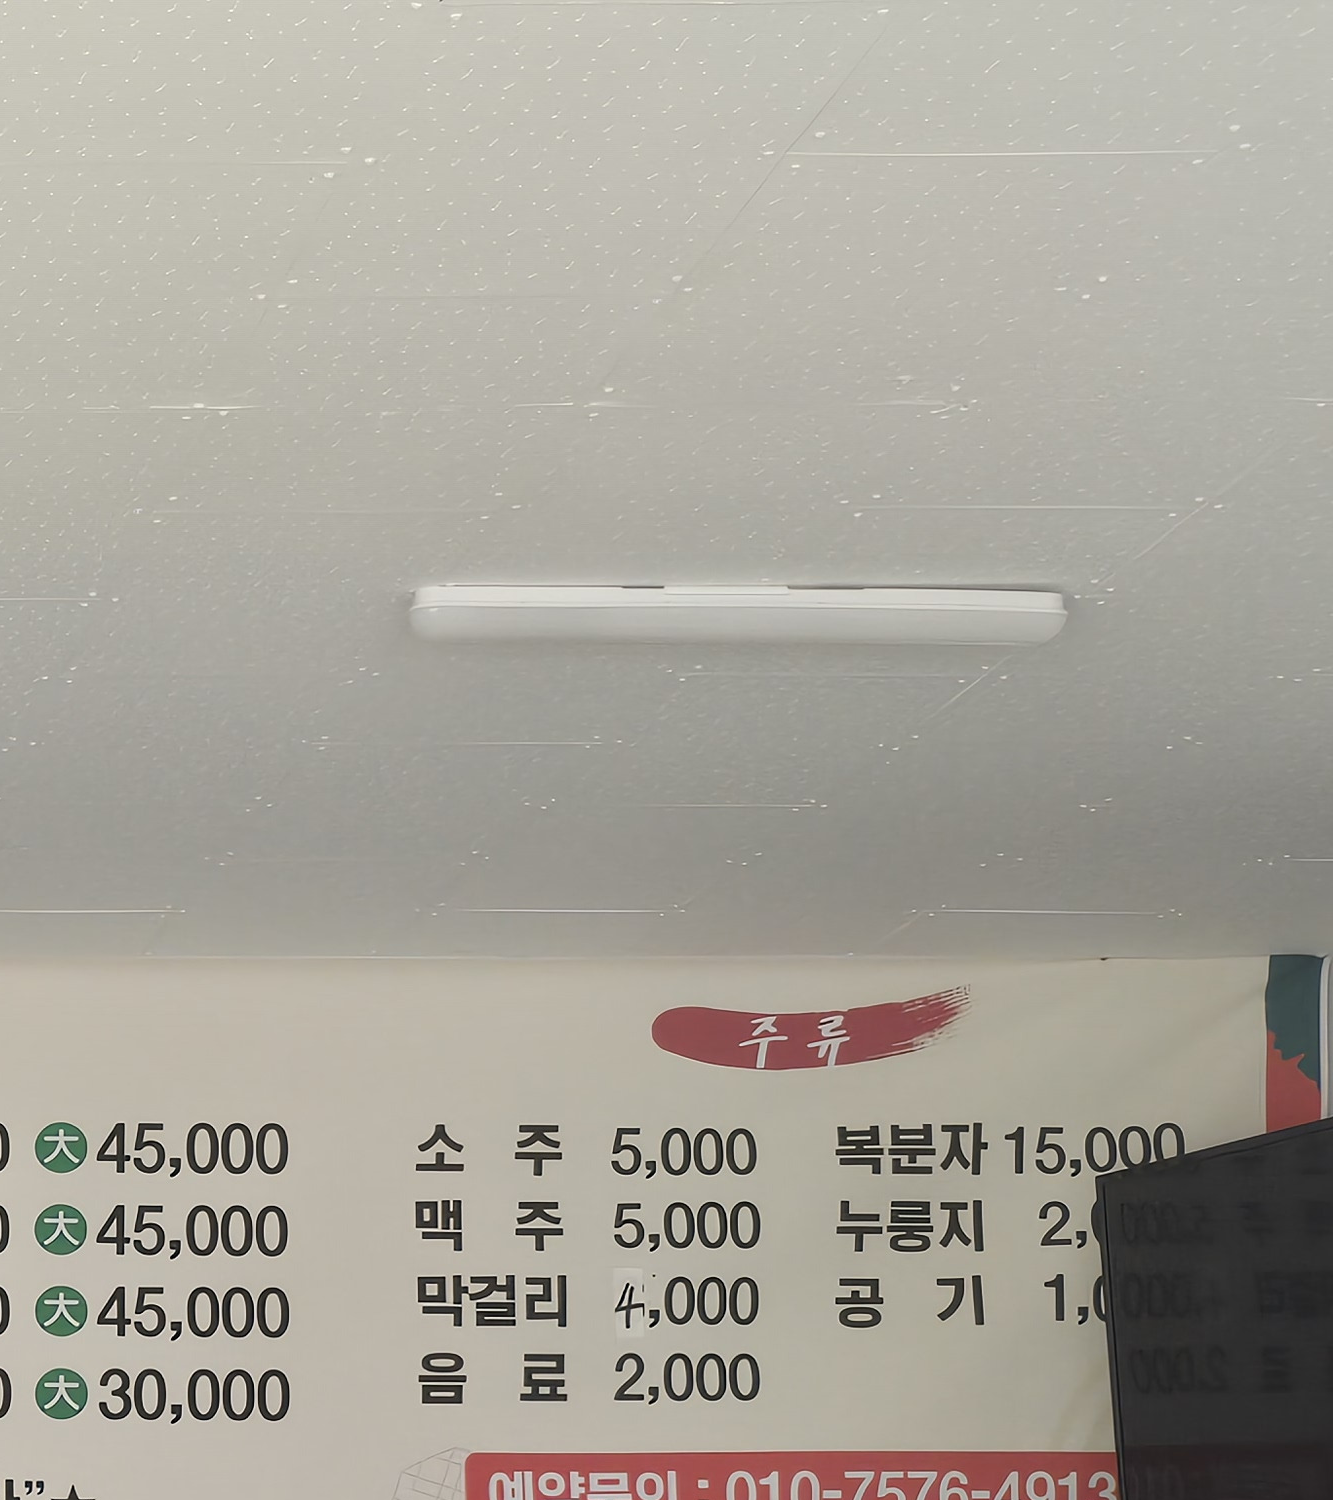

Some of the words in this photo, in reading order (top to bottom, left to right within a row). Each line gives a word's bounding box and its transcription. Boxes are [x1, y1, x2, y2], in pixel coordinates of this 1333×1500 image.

[96, 1122, 289, 1178] 45,000
[610, 1127, 758, 1180] 5,000
[835, 1122, 989, 1176] 복분자
[1004, 1122, 1185, 1178] 15,000
[95, 1204, 289, 1260] 45,000
[613, 1200, 761, 1253] 5,000
[835, 1199, 985, 1253] 누룽지
[96, 1286, 290, 1342] 45,000
[417, 1274, 567, 1328] 막걸리
[614, 1276, 760, 1330] 4,000
[98, 1368, 291, 1425] 30,000
[613, 1352, 761, 1405] 2,000
